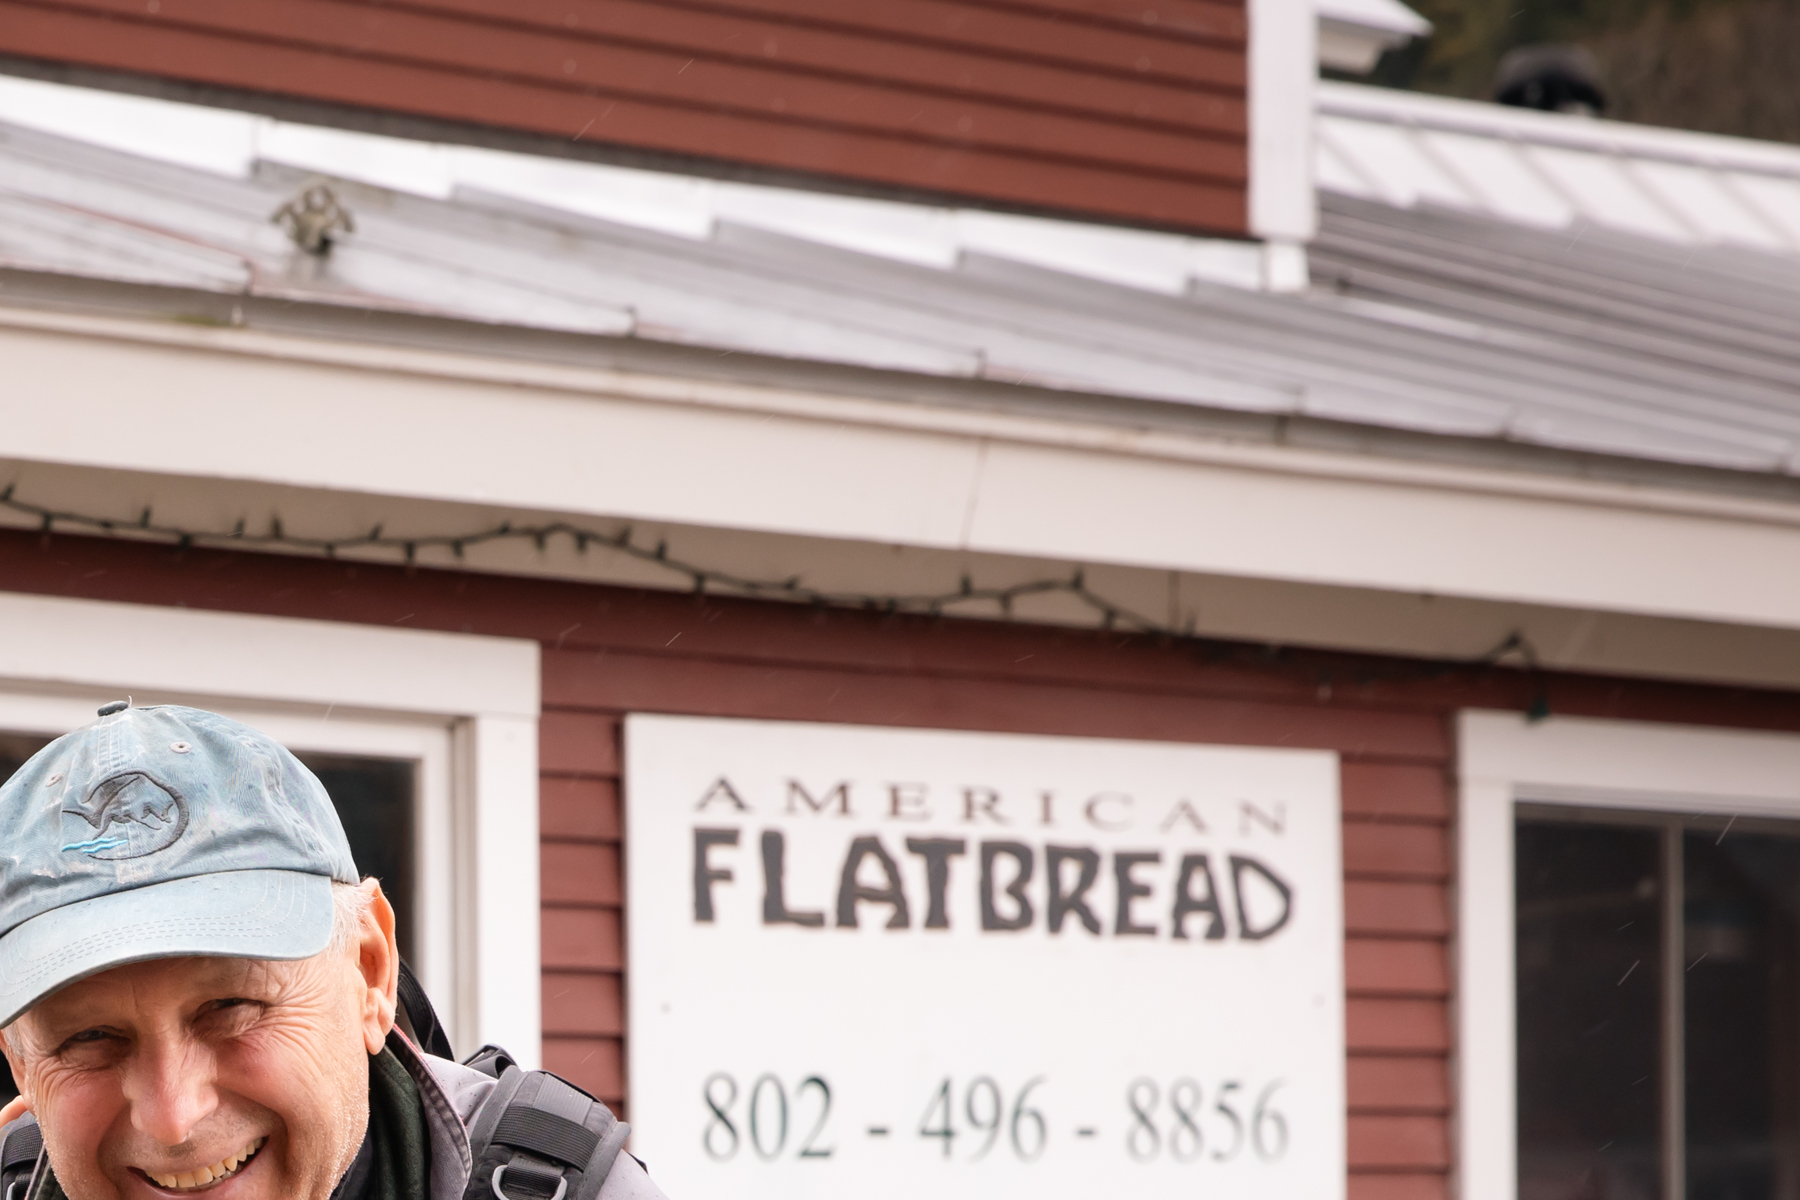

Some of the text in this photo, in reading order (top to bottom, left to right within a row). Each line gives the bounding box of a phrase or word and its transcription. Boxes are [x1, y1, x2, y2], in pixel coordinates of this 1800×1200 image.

[691, 776, 1288, 835] AMERICAN
[691, 826, 1295, 943] FLATBREAD
[702, 1072, 836, 1160] 802
[917, 1074, 1048, 1160] 496
[1126, 1077, 1289, 1162] 8856
